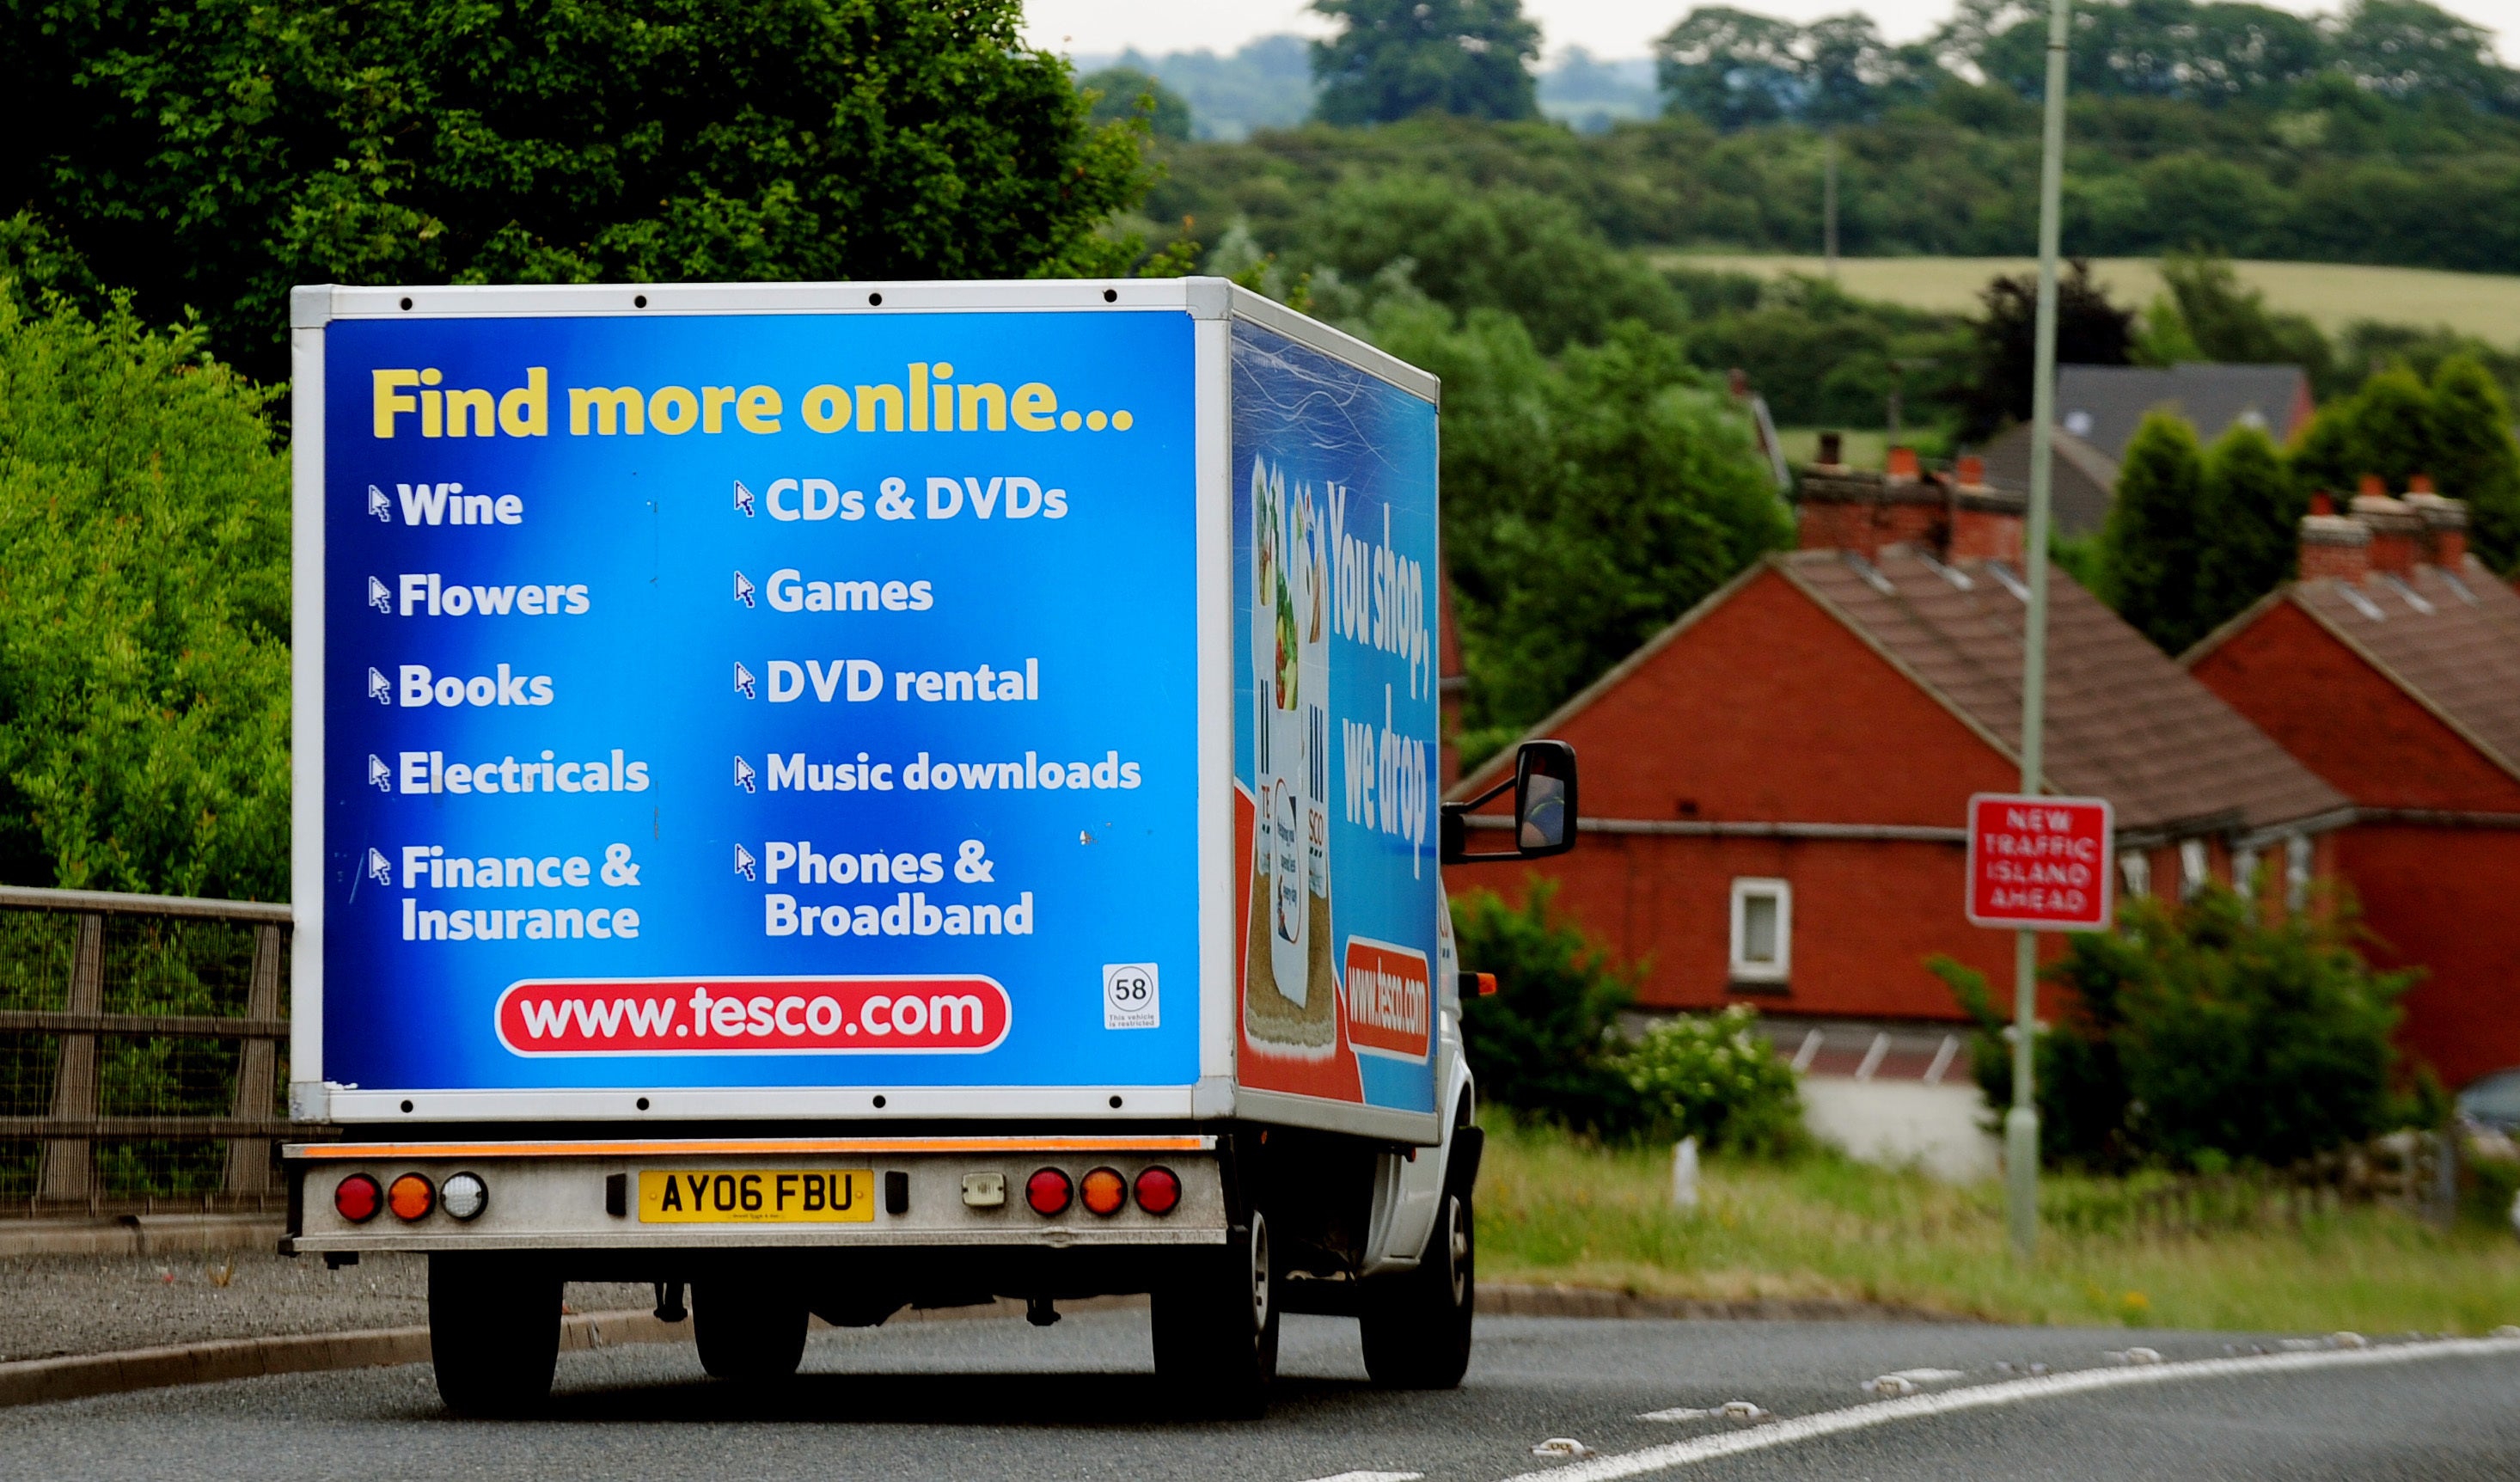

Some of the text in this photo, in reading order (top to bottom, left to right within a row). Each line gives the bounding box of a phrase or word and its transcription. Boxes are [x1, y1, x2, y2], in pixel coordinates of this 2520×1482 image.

[372, 362, 1134, 438] Find more online...
[396, 482, 523, 526] Wine
[766, 476, 1068, 522] CDs & DVDs
[399, 573, 590, 616] Flowers
[766, 568, 933, 613] Games
[1326, 480, 1430, 703] You shop,
[399, 663, 554, 707] Books
[768, 658, 1038, 702] DVD rental
[399, 749, 650, 794] Electricals
[767, 750, 1141, 792] Music downloads
[1343, 683, 1428, 880] we drop
[2006, 807, 2073, 832] NEW
[402, 842, 640, 889] Finance &
[765, 839, 994, 885] Phones &
[1984, 833, 2097, 863] TRAFFIC
[1985, 860, 2092, 889] ISLAND
[402, 897, 640, 940] Insurance
[765, 891, 1033, 936] Broadband
[1990, 885, 2089, 913] AHEAD
[1116, 978, 1147, 1001] 58
[1348, 955, 1427, 1035] www.tesco.com
[520, 986, 984, 1038] www.tesco.com
[662, 1173, 853, 1212] AY06 FBU
